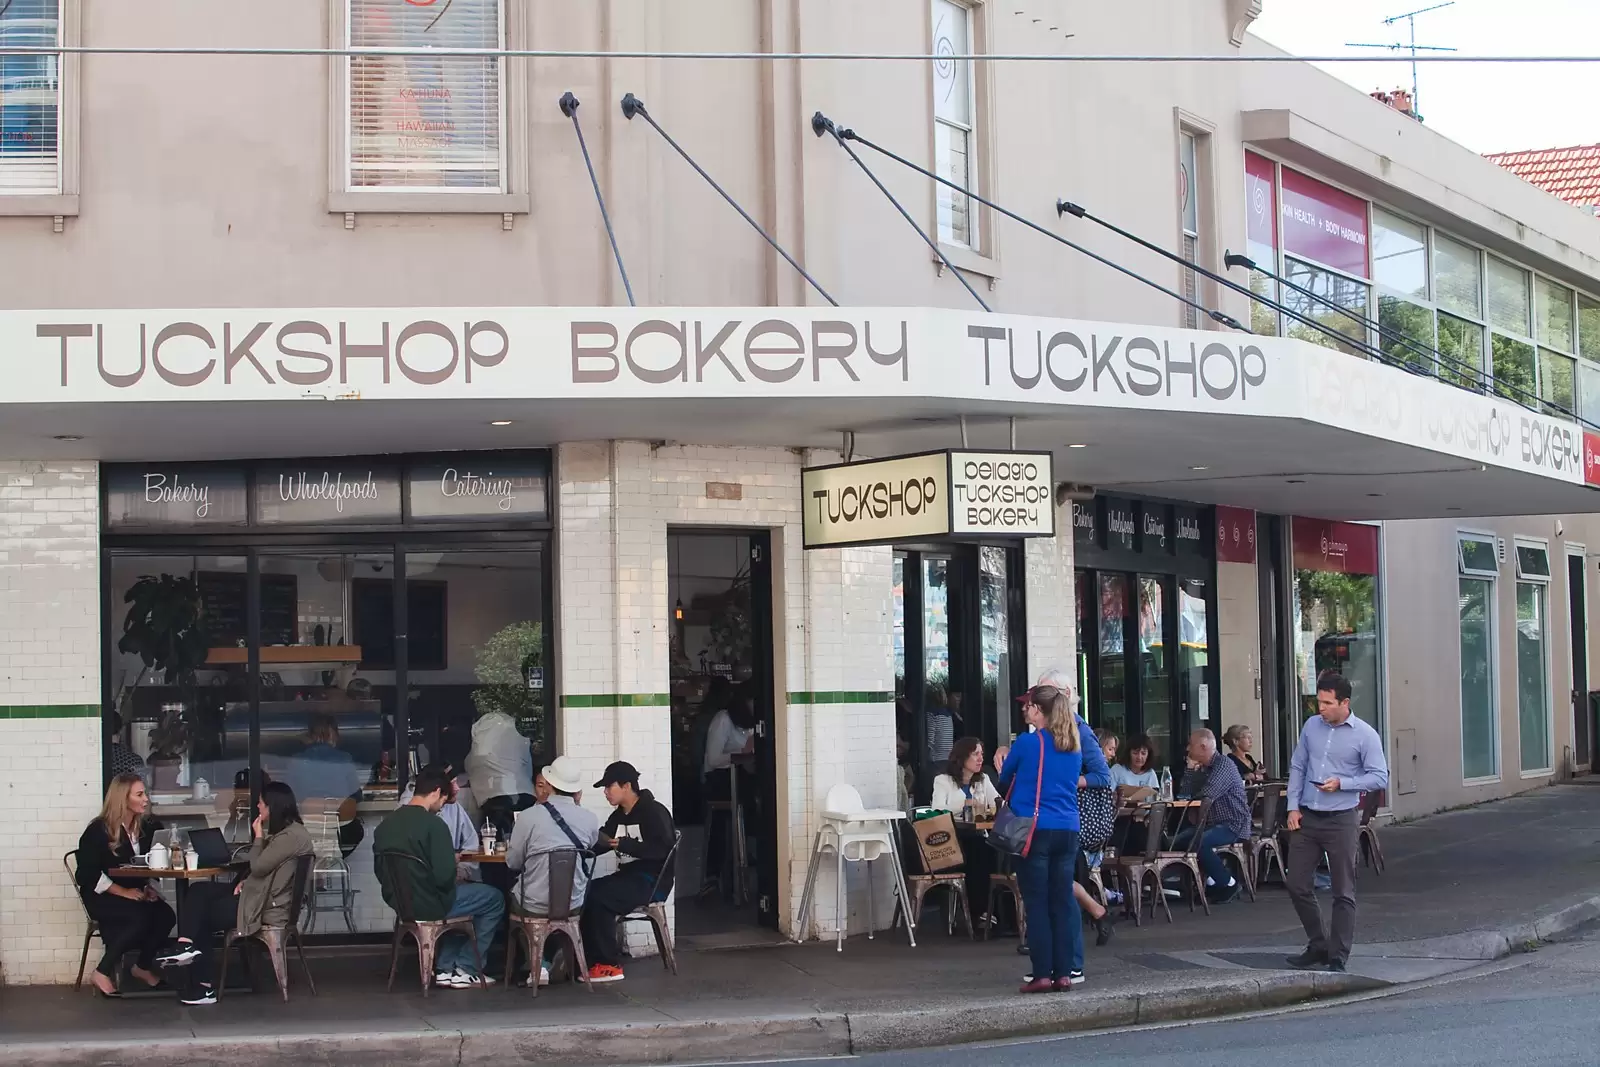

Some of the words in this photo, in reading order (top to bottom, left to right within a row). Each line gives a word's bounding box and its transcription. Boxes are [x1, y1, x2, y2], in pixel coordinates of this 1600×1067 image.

[1294, 208, 1315, 226] HEALTH
[1325, 220, 1340, 236] BODY
[1341, 227, 1365, 245] HARMONY
[36, 320, 509, 388] TUCKSHOP
[967, 325, 1267, 401] TUCKSHOP
[143, 473, 212, 517] Bakery
[280, 472, 379, 513] Wholefoods
[441, 468, 517, 510] Catering
[813, 476, 937, 524] TUCKSHOP
[954, 484, 1049, 503] TUCKSHOP
[1072, 503, 1095, 540] Bakery
